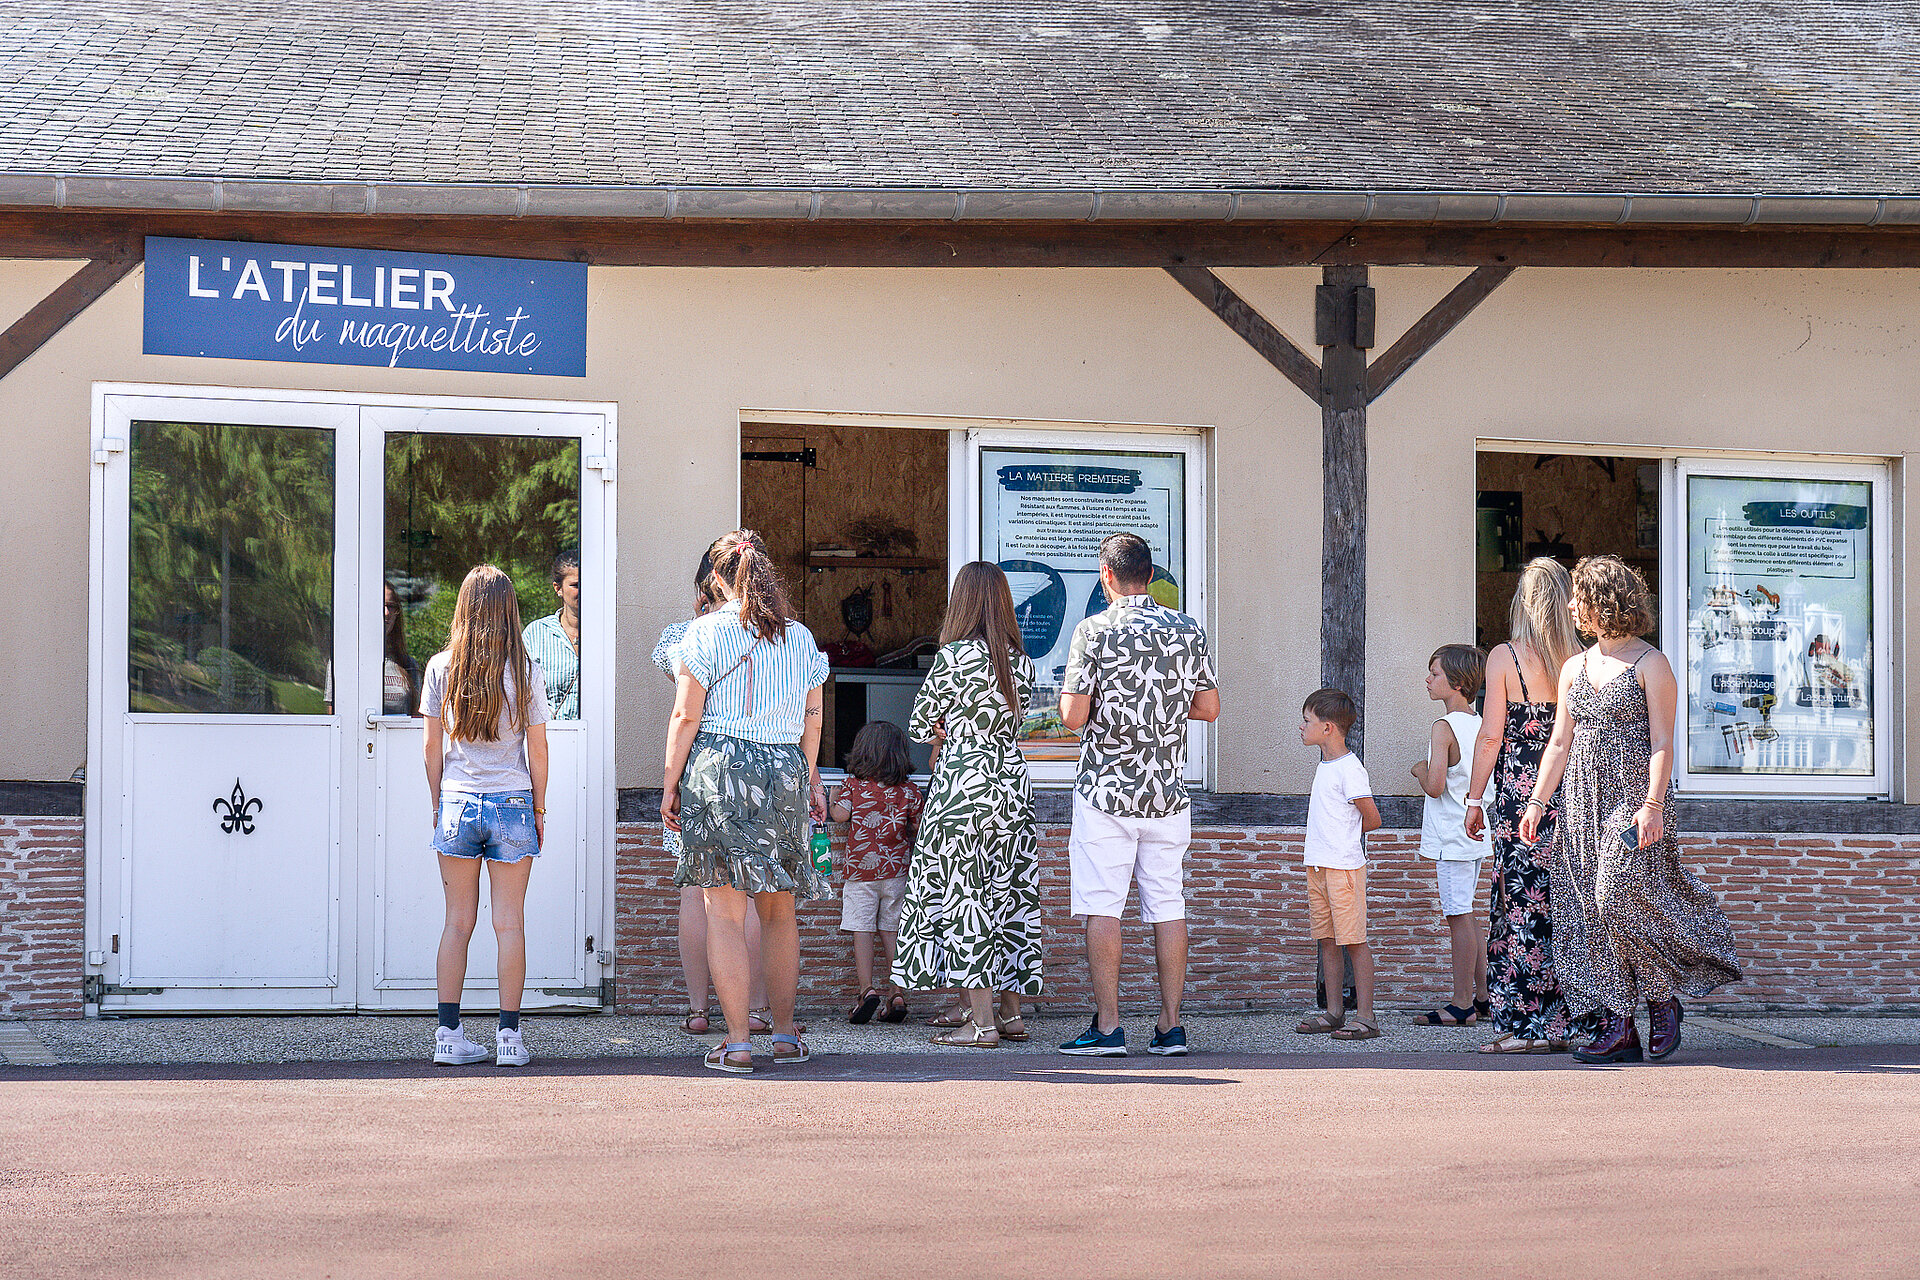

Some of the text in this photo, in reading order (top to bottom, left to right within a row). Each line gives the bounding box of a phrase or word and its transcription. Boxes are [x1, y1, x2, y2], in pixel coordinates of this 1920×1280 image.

[189, 255, 456, 312] L'ATELIER
[275, 287, 542, 368] du maquettiste
[1008, 471, 1023, 481] LA
[1780, 509, 1836, 520] LES OUTILS
[1713, 678, 1776, 691] L'assemblage
[1801, 692, 1812, 701] La
[436, 1044, 453, 1054] IKE
